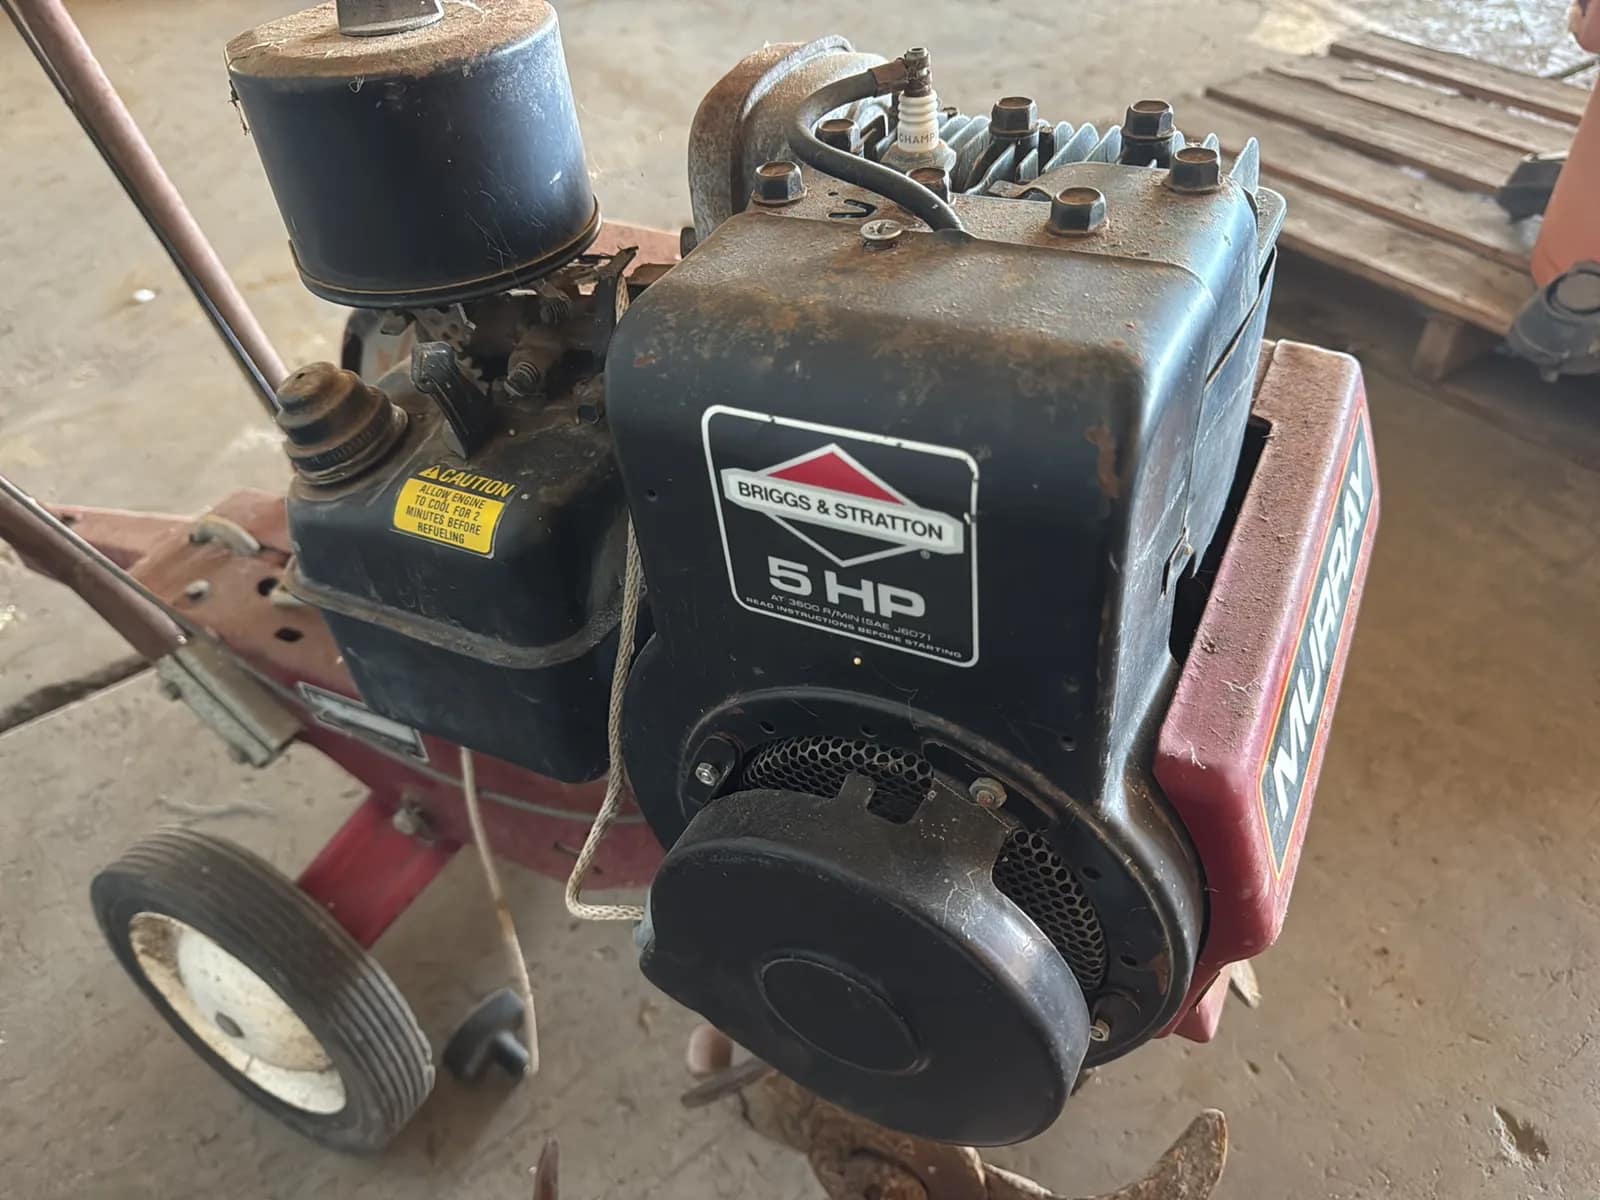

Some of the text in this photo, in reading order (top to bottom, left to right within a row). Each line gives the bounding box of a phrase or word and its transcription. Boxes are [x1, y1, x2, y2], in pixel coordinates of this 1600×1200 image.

[419, 484, 486, 509] ALLOW ENGINE
[440, 469, 517, 497] CAUTION
[406, 506, 481, 535] MINUTES BEFORE
[415, 495, 480, 522] TO COOL FOR 2
[738, 481, 943, 540] BRIGGS & STRATTON
[417, 522, 464, 544] REFUELING
[767, 555, 926, 618] 5 HP
[770, 594, 785, 602] AT
[788, 598, 820, 612] 3600
[822, 607, 860, 622] R/MIN
[745, 596, 962, 658] READ INSTRUCTIONS BEFORE STARTING
[1273, 441, 1366, 821] MURRAY
